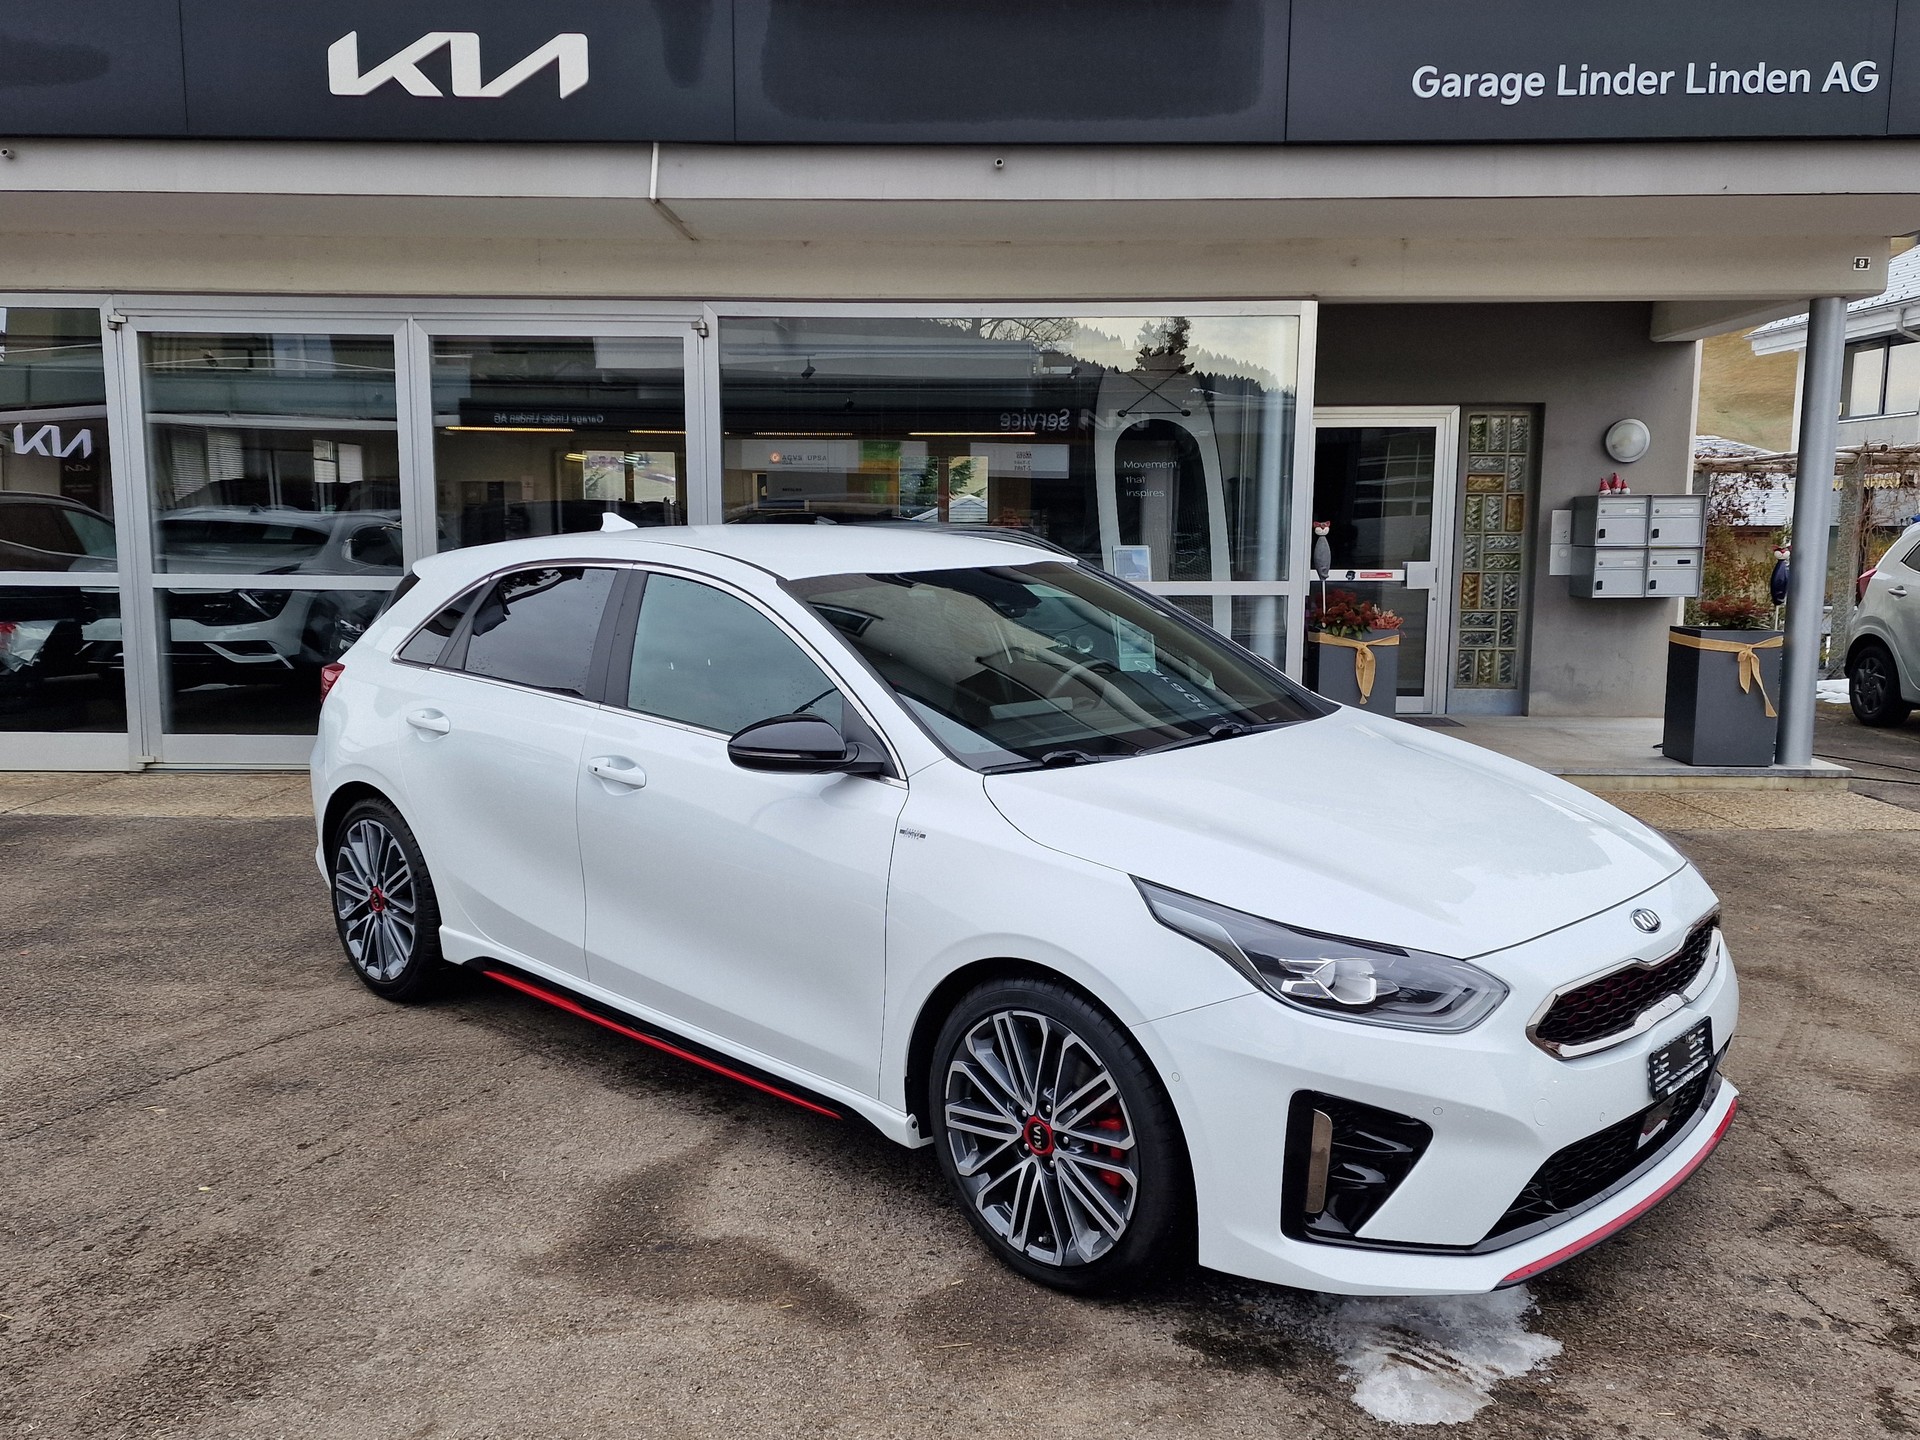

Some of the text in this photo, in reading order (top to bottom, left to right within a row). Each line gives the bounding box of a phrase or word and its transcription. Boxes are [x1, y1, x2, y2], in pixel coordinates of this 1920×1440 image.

[328, 30, 589, 99] KIA
[1412, 60, 1879, 105] Garage Linder Linden AG
[1858, 259, 1866, 268] 9
[13, 422, 92, 459] KIA
[1123, 461, 1177, 469] Movement
[1126, 475, 1146, 484] that
[1126, 488, 1165, 499] inspires
[1635, 911, 1660, 930] KIA
[1033, 1125, 1042, 1149] KIA
